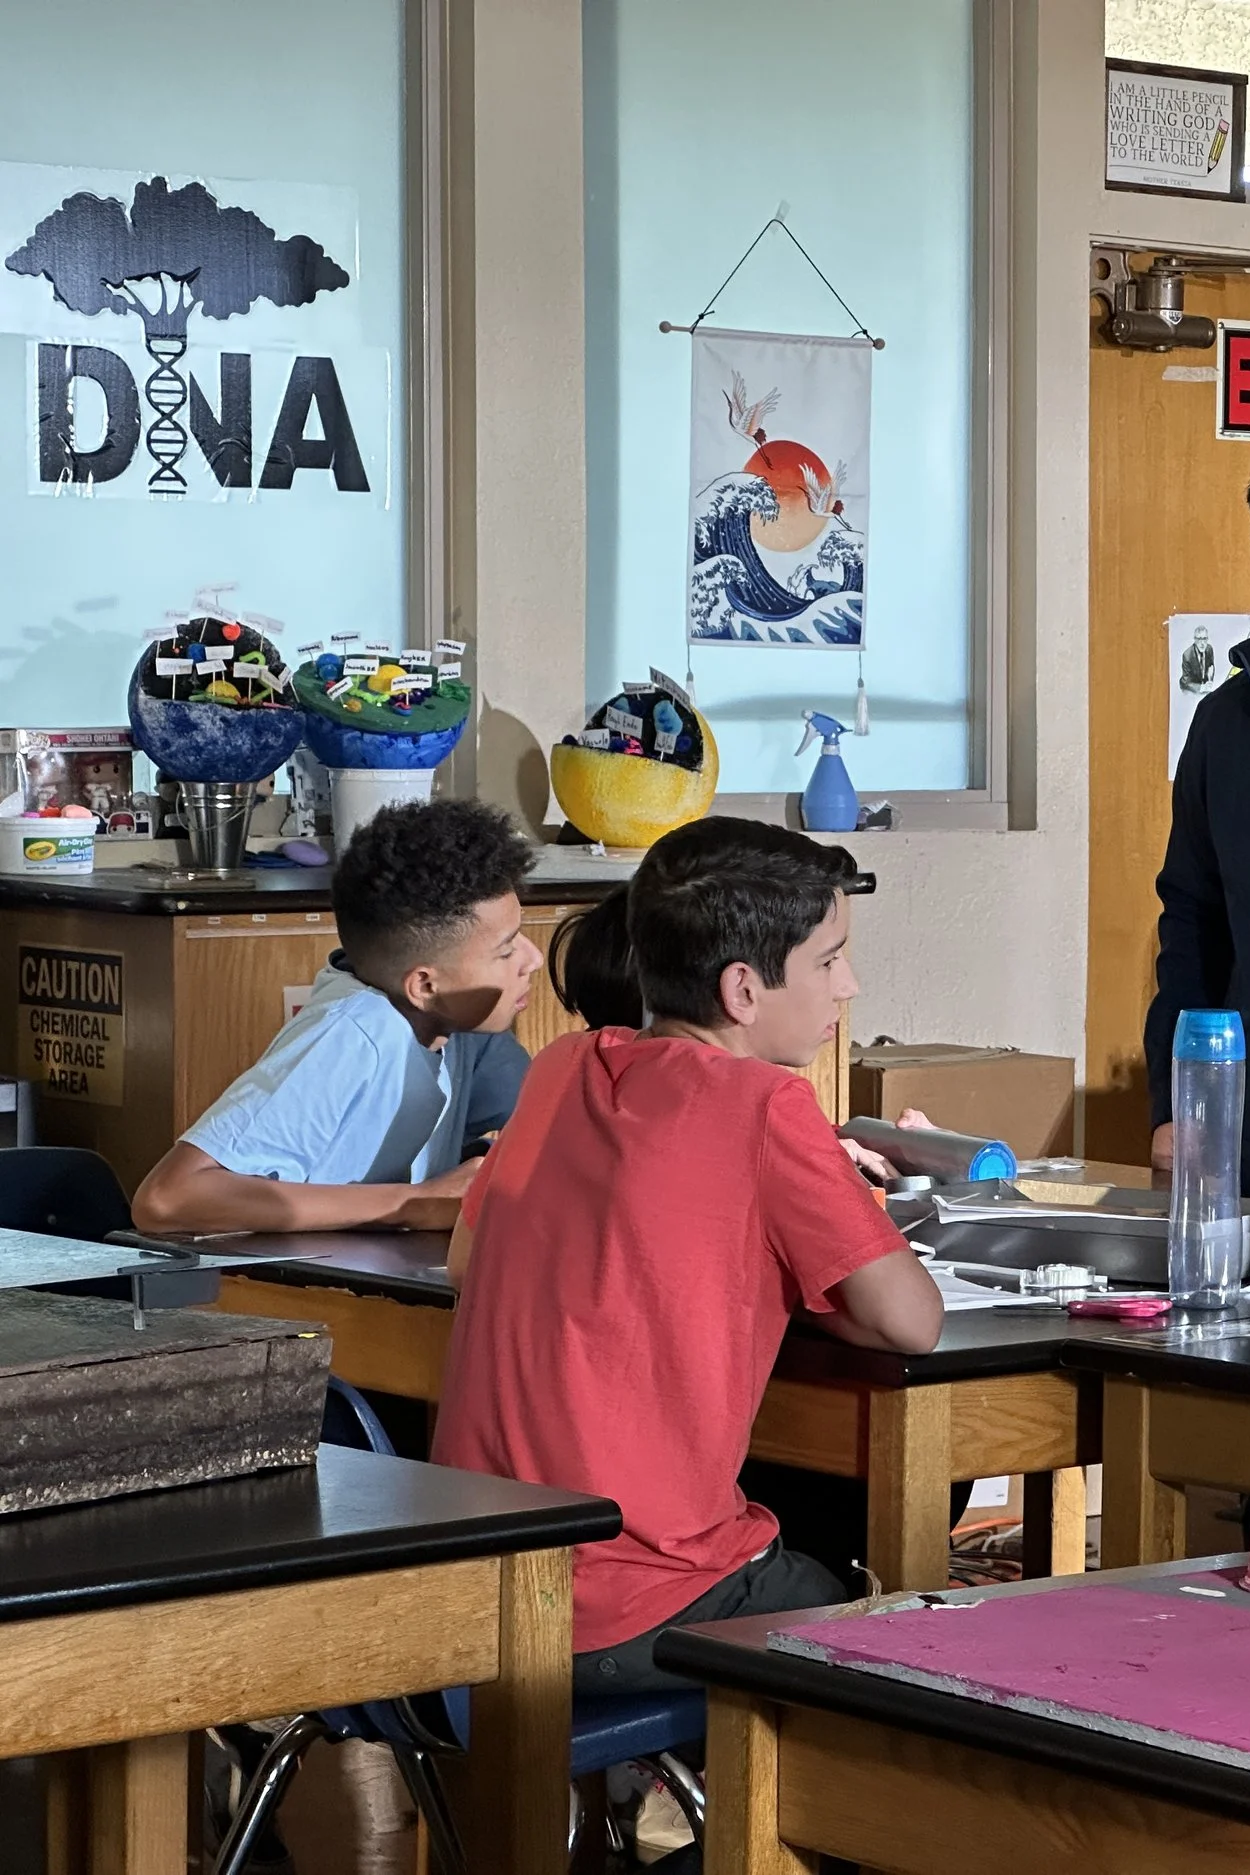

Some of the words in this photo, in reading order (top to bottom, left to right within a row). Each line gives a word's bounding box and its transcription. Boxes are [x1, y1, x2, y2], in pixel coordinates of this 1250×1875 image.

[1109, 92, 1121, 105] IN
[1127, 95, 1151, 109] THE
[1156, 98, 1191, 113] HAND
[1195, 103, 1210, 115] OF
[1215, 106, 1222, 117] A
[1117, 83, 1135, 94] AM
[1139, 86, 1146, 96] A
[1150, 86, 1188, 101] LITTLE
[1192, 92, 1229, 106] PENCIL
[1110, 105, 1177, 126] WRITING
[1183, 114, 1215, 131] GOD
[1110, 120, 1137, 133] WHO
[1141, 124, 1150, 135] IS
[1153, 126, 1199, 141] SENDING
[1203, 132, 1210, 142] A
[1110, 132, 1146, 148] LOVE
[1151, 137, 1204, 156] LETTER
[1110, 146, 1127, 158] TO
[1131, 149, 1155, 162] THE
[1159, 152, 1203, 167] WORLD
[37, 342, 371, 493] DNA
[21, 956, 120, 1006] CAUTION
[30, 1009, 110, 1042] CHEMICAL
[34, 1038, 105, 1069] STORAGE
[48, 1068, 89, 1095] AREA
